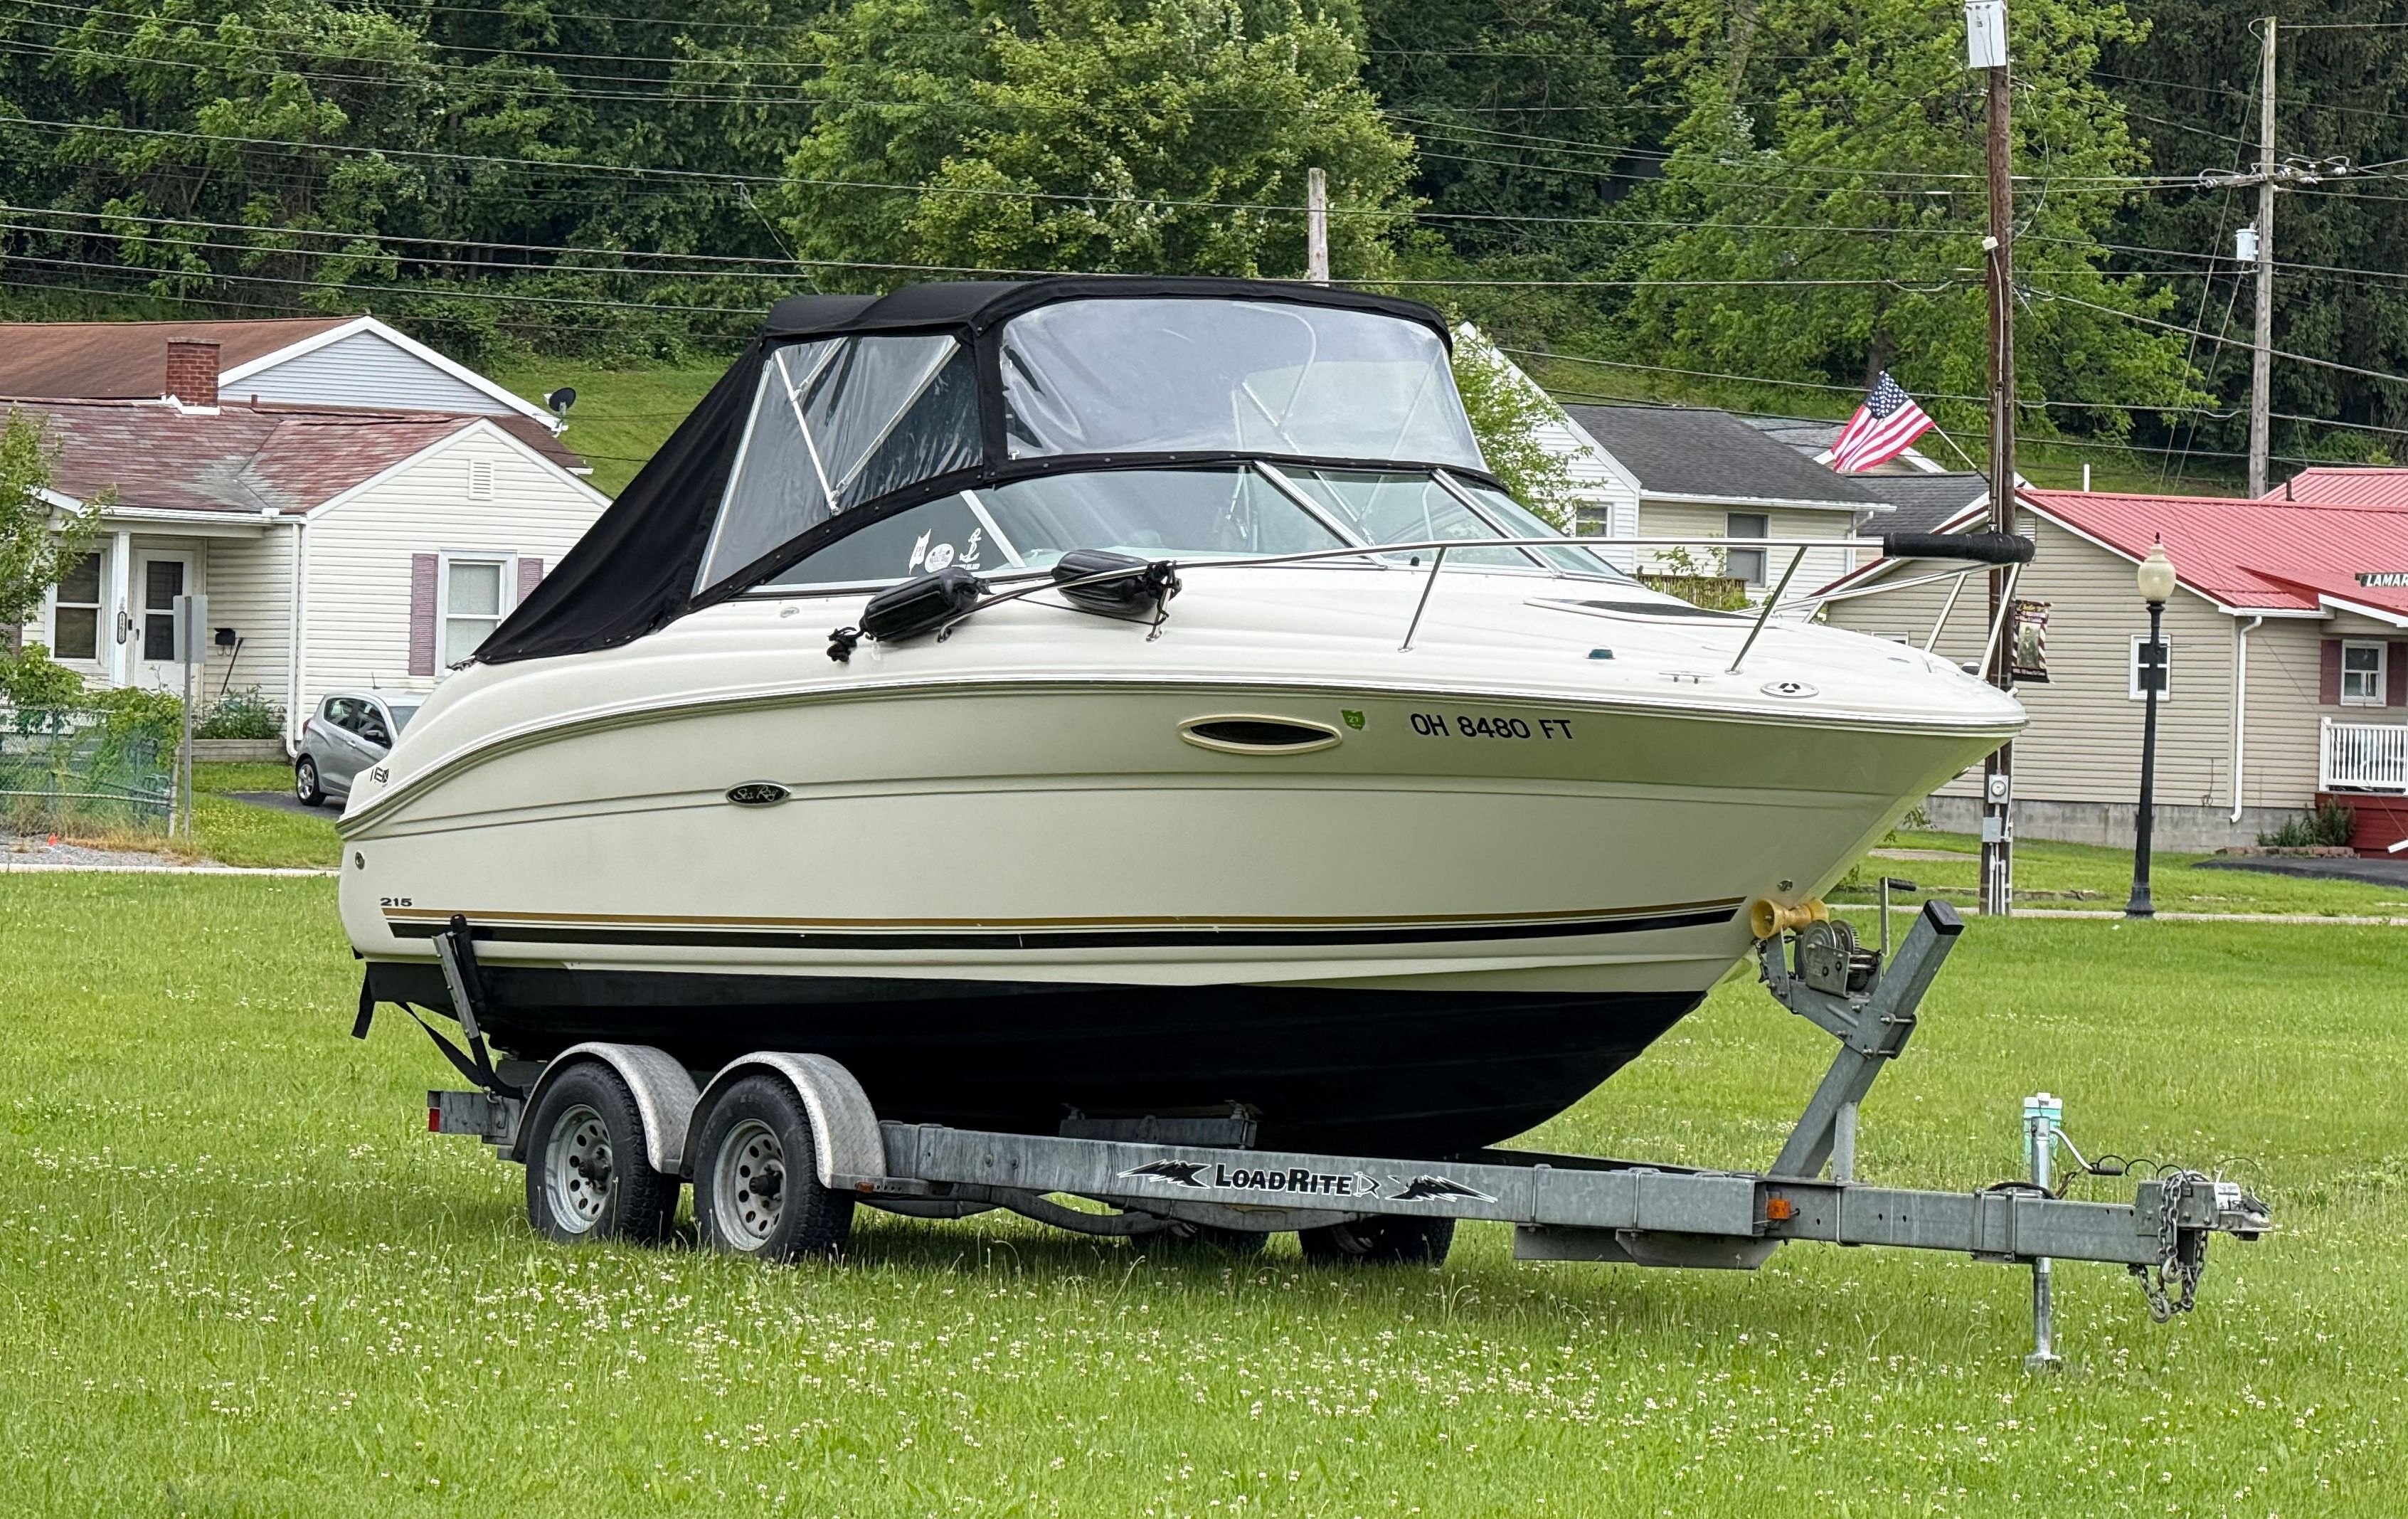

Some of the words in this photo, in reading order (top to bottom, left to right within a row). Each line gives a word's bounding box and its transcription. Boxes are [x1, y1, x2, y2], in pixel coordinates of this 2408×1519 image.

[2366, 573, 2408, 587] LAMAR
[1411, 713, 1450, 736] OH
[1457, 716, 1530, 739] 8480
[1538, 719, 1574, 739] FT
[380, 897, 413, 907] 215
